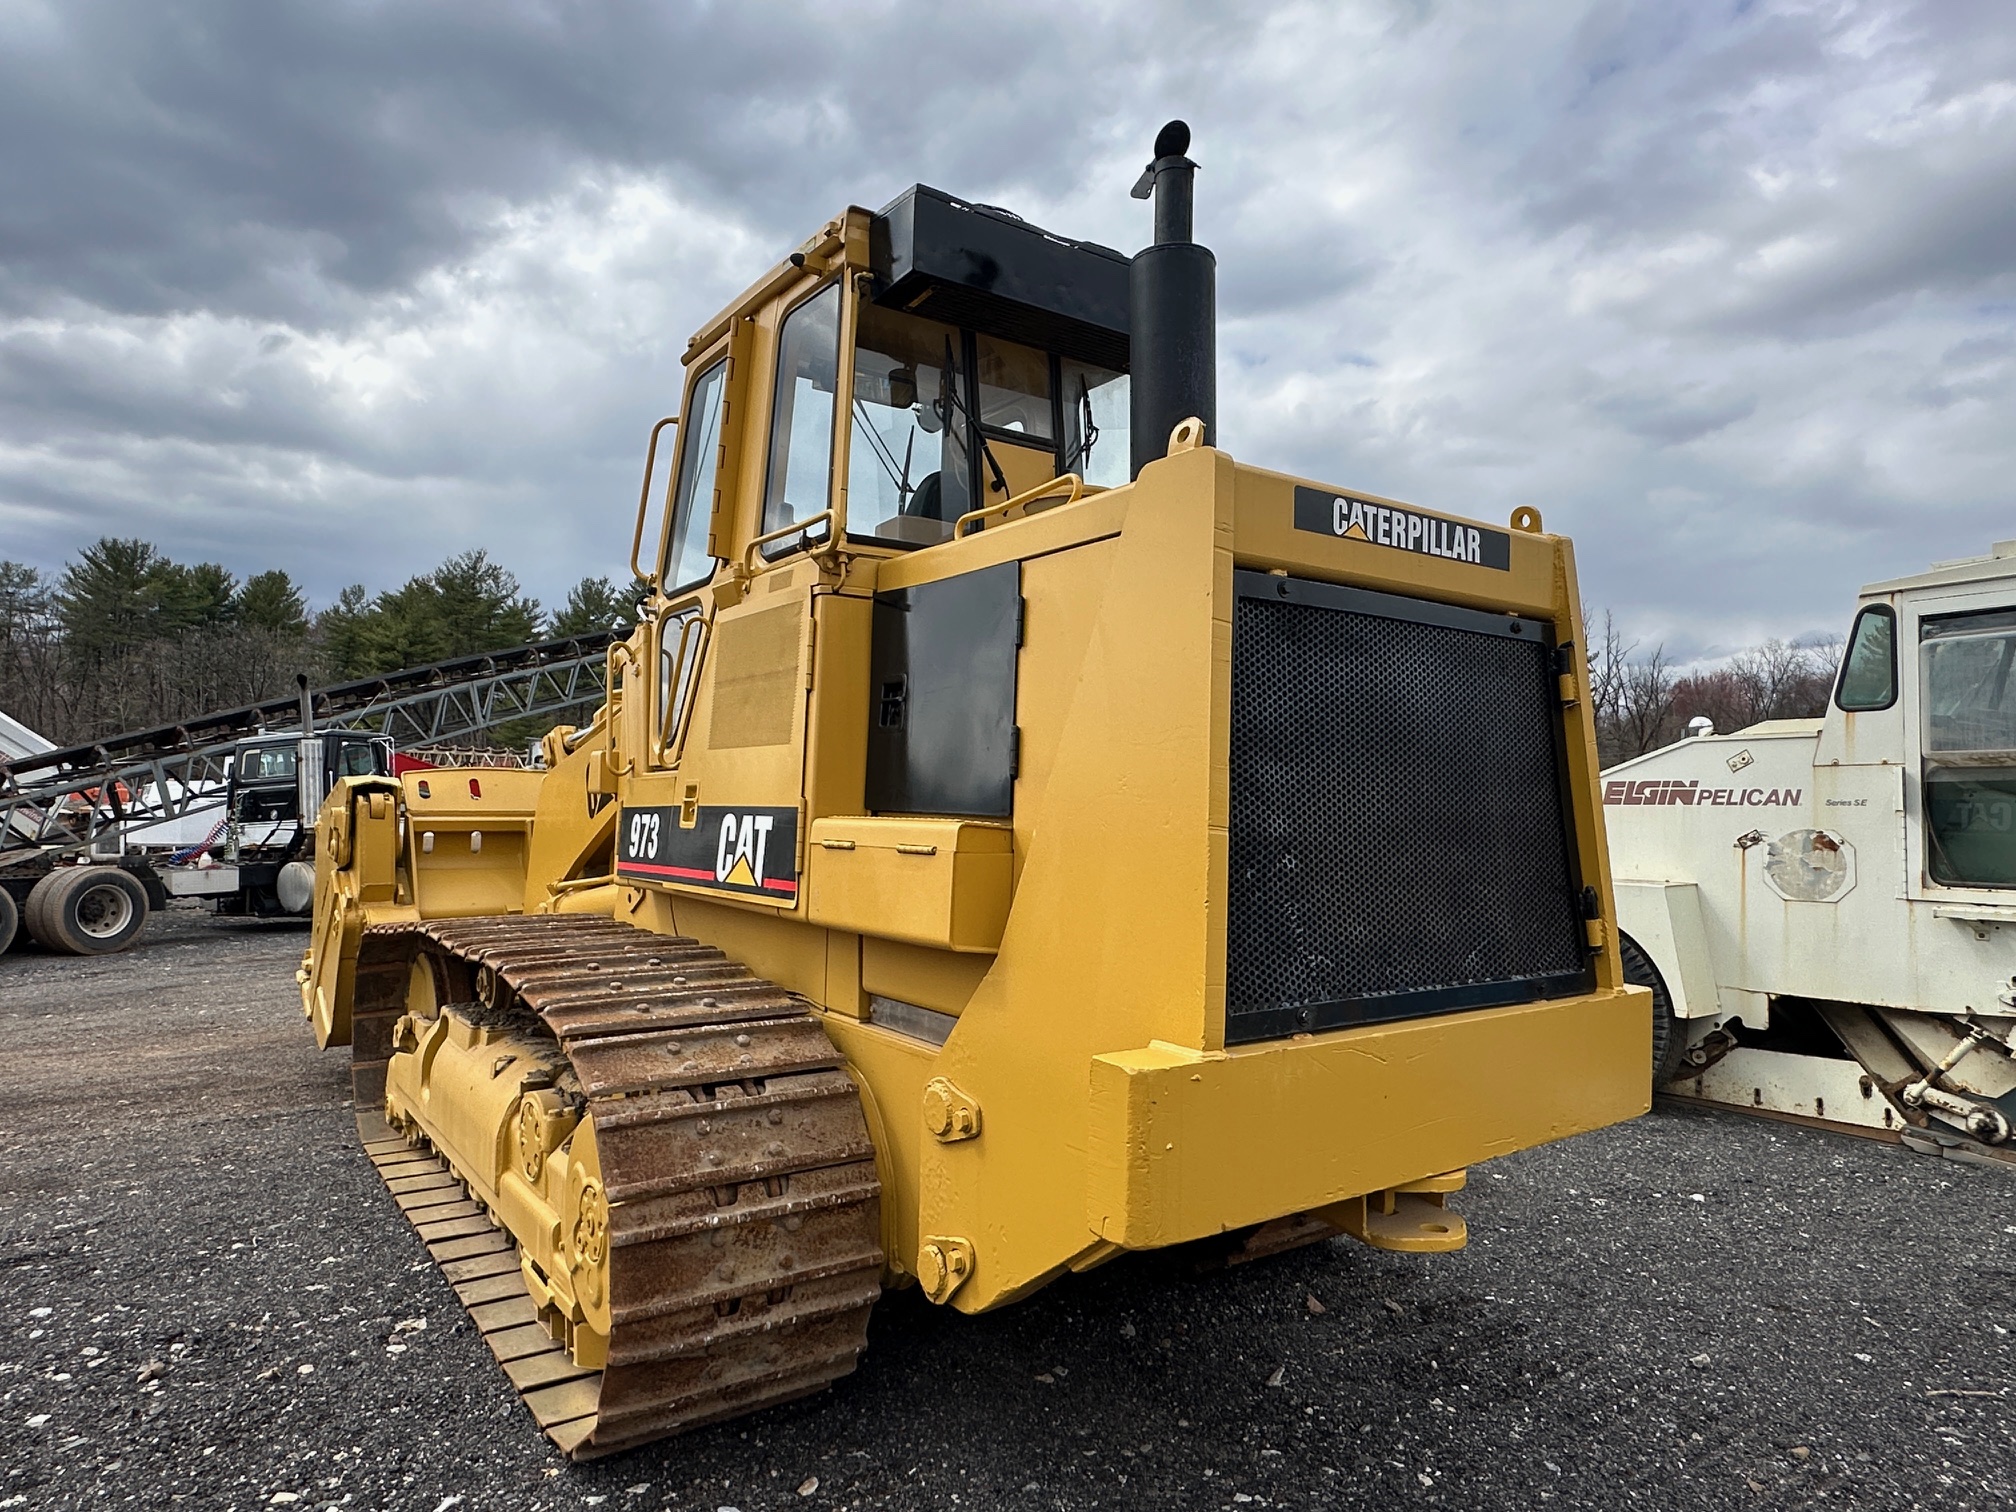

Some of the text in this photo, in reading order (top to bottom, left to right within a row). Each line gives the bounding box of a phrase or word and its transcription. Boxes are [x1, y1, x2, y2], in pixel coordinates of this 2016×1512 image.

[1333, 497, 1481, 564] CATERPILLAR
[1602, 780, 1802, 807] ELGIN PELICAN
[1825, 798, 1852, 807] Series
[629, 813, 660, 860] 973
[716, 812, 774, 888] CAT
